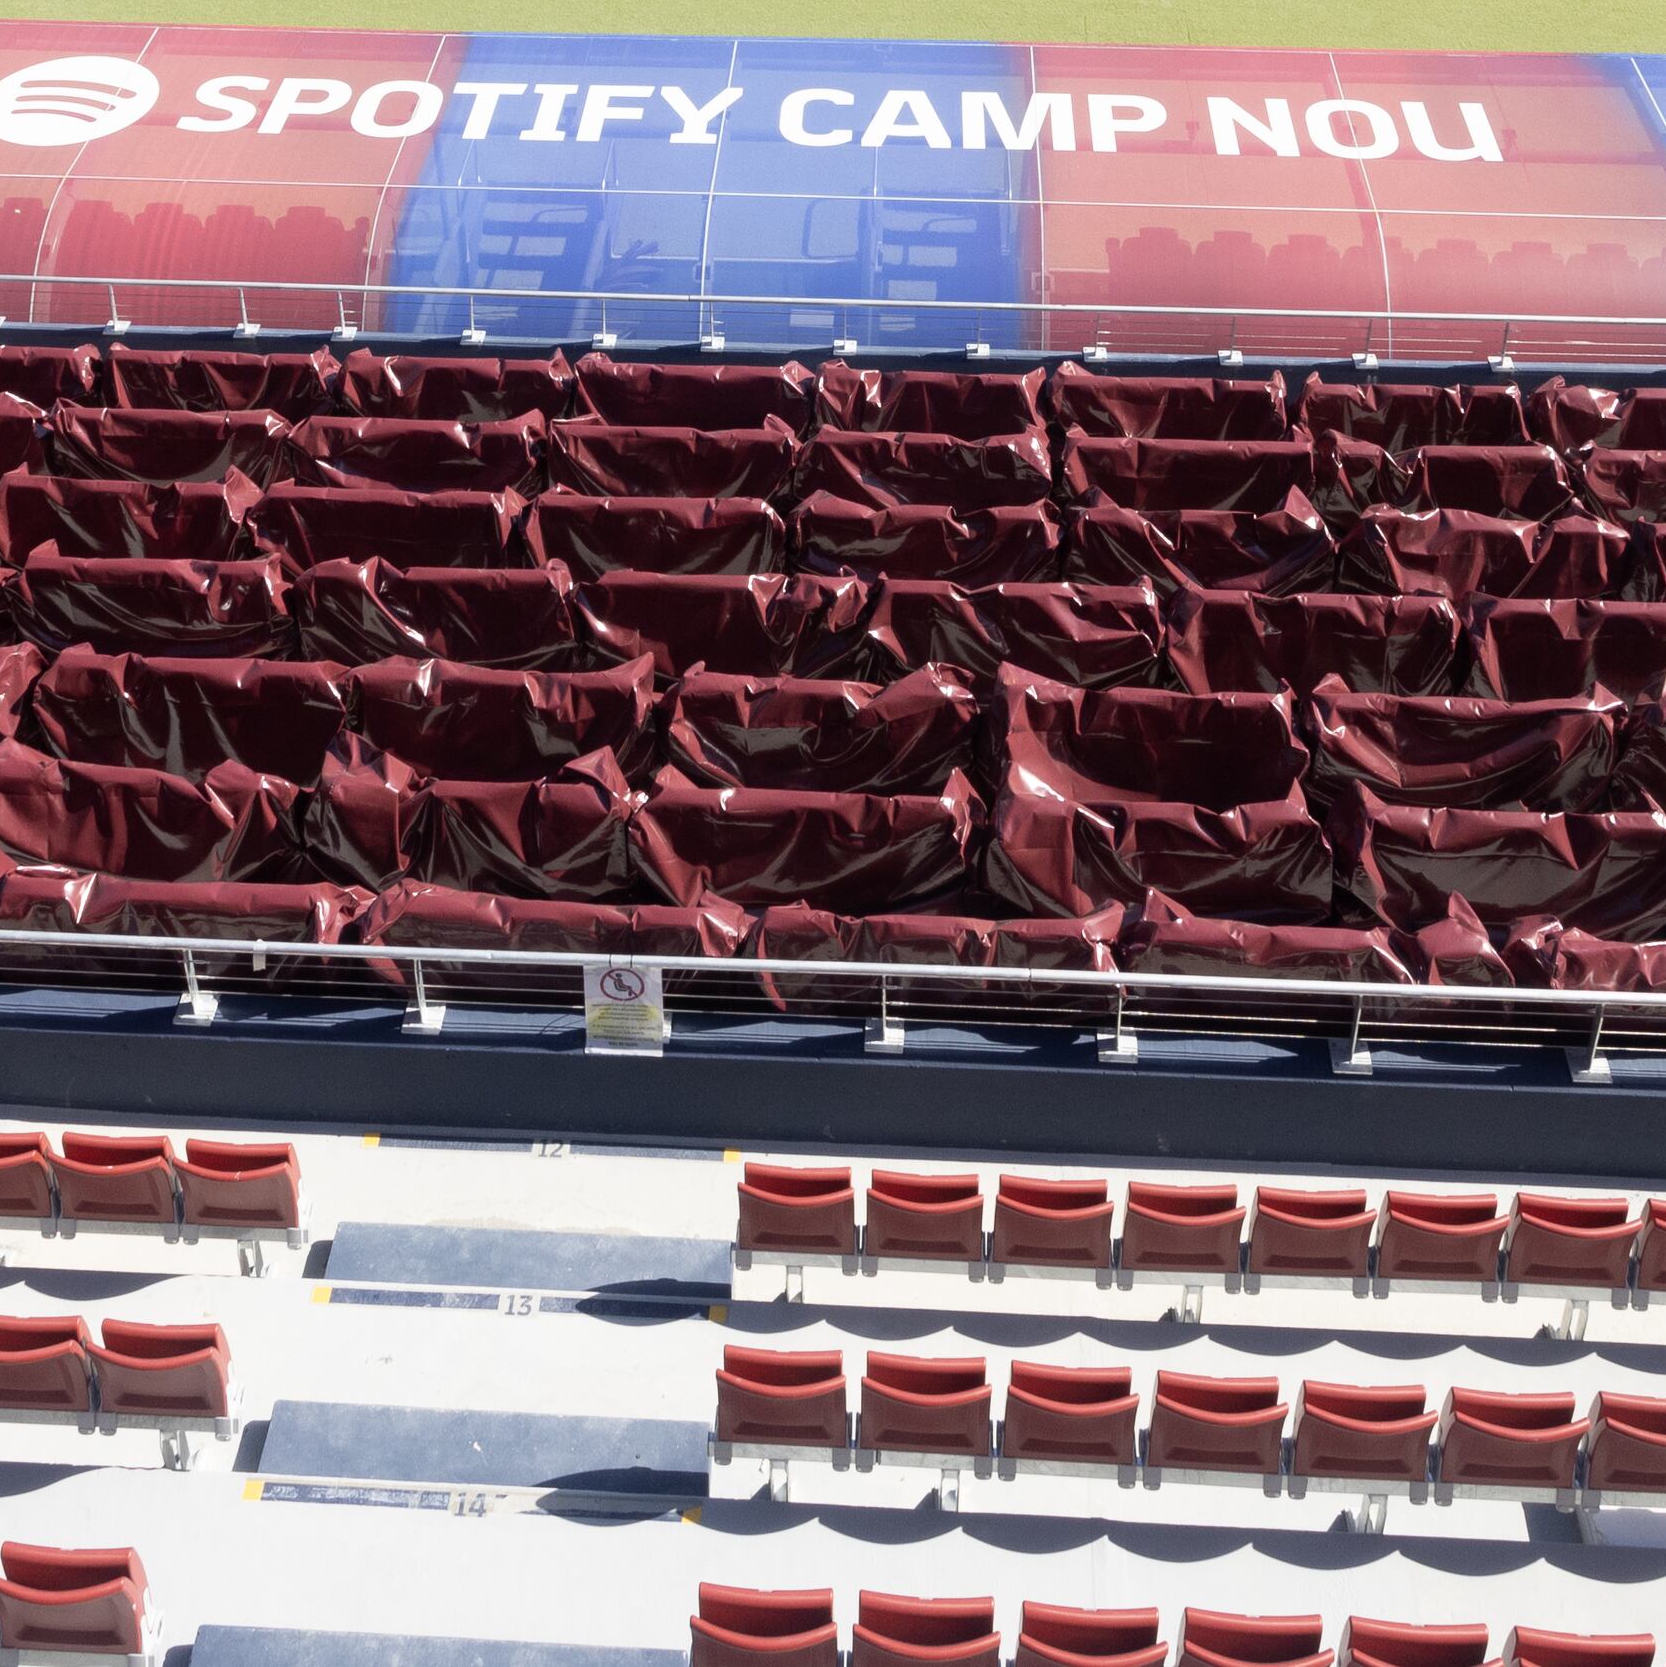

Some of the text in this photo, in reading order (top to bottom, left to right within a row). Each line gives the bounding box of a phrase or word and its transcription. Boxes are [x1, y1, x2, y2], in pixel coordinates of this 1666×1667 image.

[177, 73, 1506, 164] SPOTIFY CAMP NOU
[537, 1139, 564, 1158] 12
[503, 1294, 534, 1317] 13
[453, 1492, 487, 1518] 14
